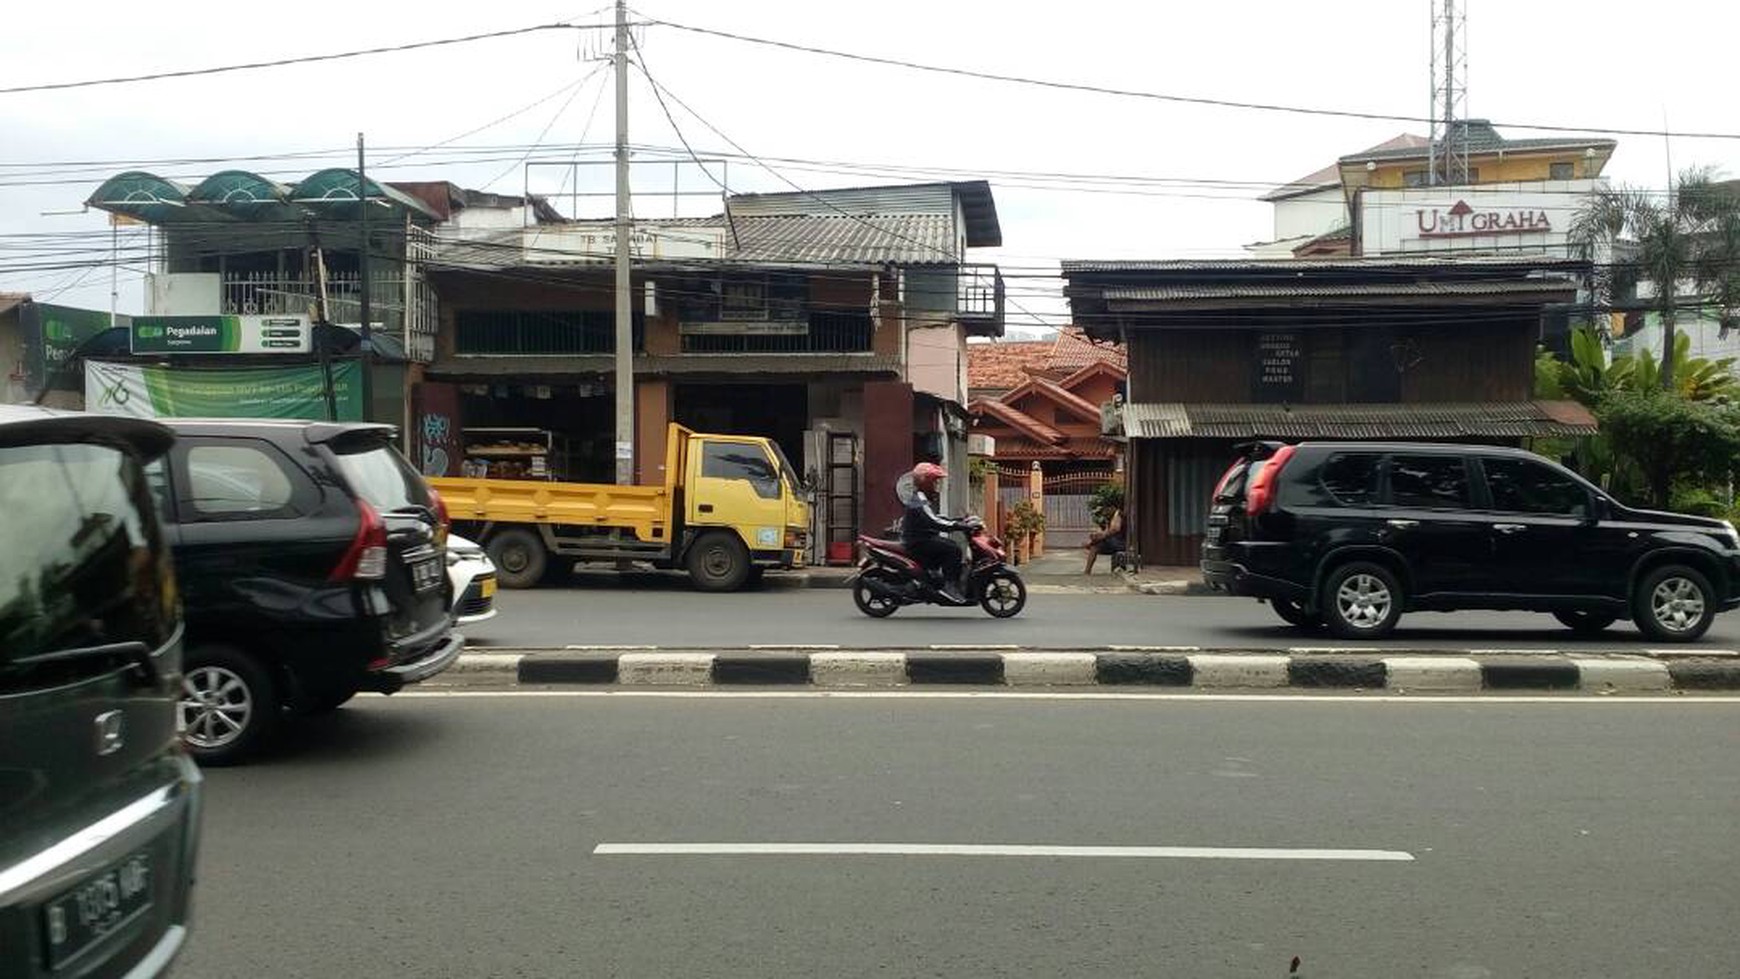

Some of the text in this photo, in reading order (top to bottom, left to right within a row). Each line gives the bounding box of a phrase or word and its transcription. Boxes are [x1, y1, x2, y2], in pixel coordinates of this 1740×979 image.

[1472, 210, 1551, 230] GRAHA
[580, 234, 659, 244] TB SAABAT
[166, 325, 217, 338] Pegadaian
